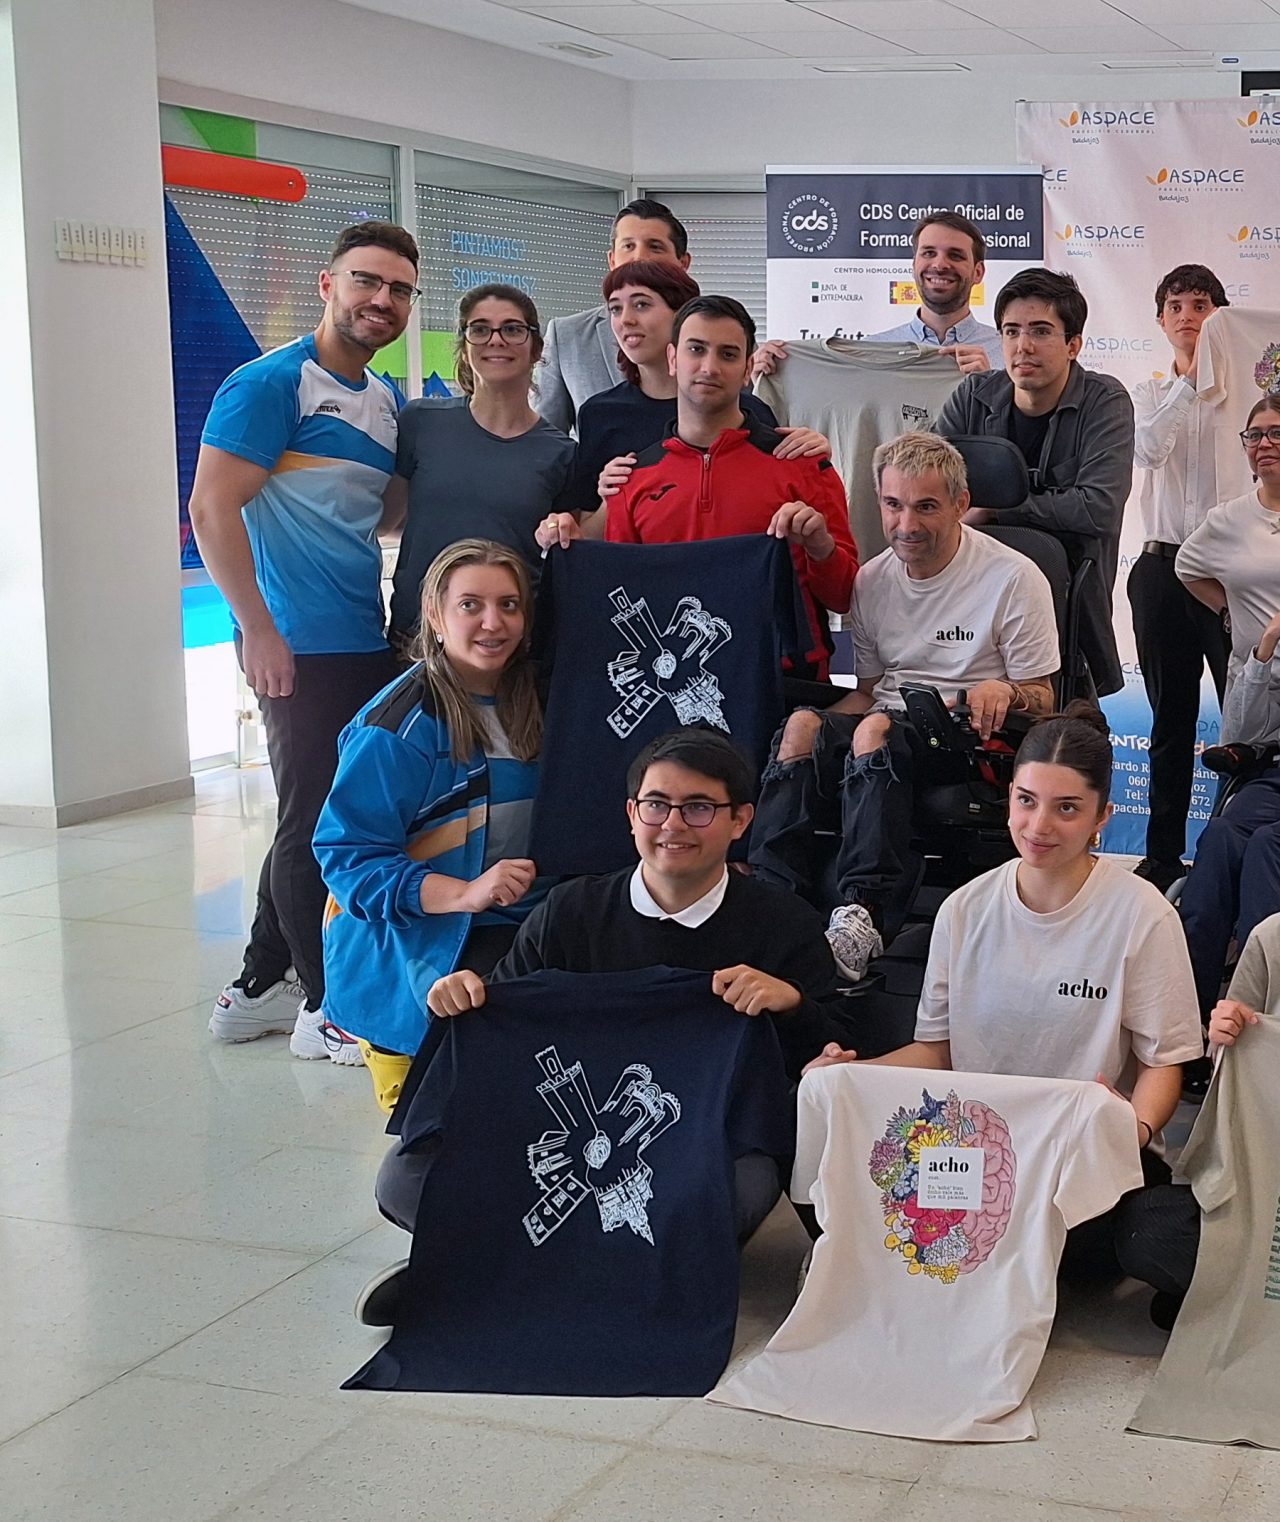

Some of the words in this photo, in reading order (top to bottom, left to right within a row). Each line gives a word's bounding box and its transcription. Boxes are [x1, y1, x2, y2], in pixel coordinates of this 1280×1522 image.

[1081, 110, 1155, 128] ASPACE
[1170, 169, 1245, 185] ASPACE
[788, 194, 817, 209] CENTRO
[819, 197, 830, 208] DE
[860, 203, 893, 220] CDS
[954, 204, 1000, 220] Oficial
[1005, 204, 1024, 220] de
[791, 209, 829, 231] cds
[860, 231, 914, 247] Formac
[981, 232, 1031, 247] sional
[1074, 225, 1145, 241] ASPACE
[821, 284, 838, 292] JUNTA
[820, 294, 863, 302] EXTREMADURA
[1085, 337, 1153, 354] ASPACE
[936, 626, 974, 641] acho
[1108, 734, 1151, 751] ENTR
[1125, 788, 1144, 800] Tel:
[1058, 978, 1108, 1000] acho
[928, 1156, 969, 1173] acho
